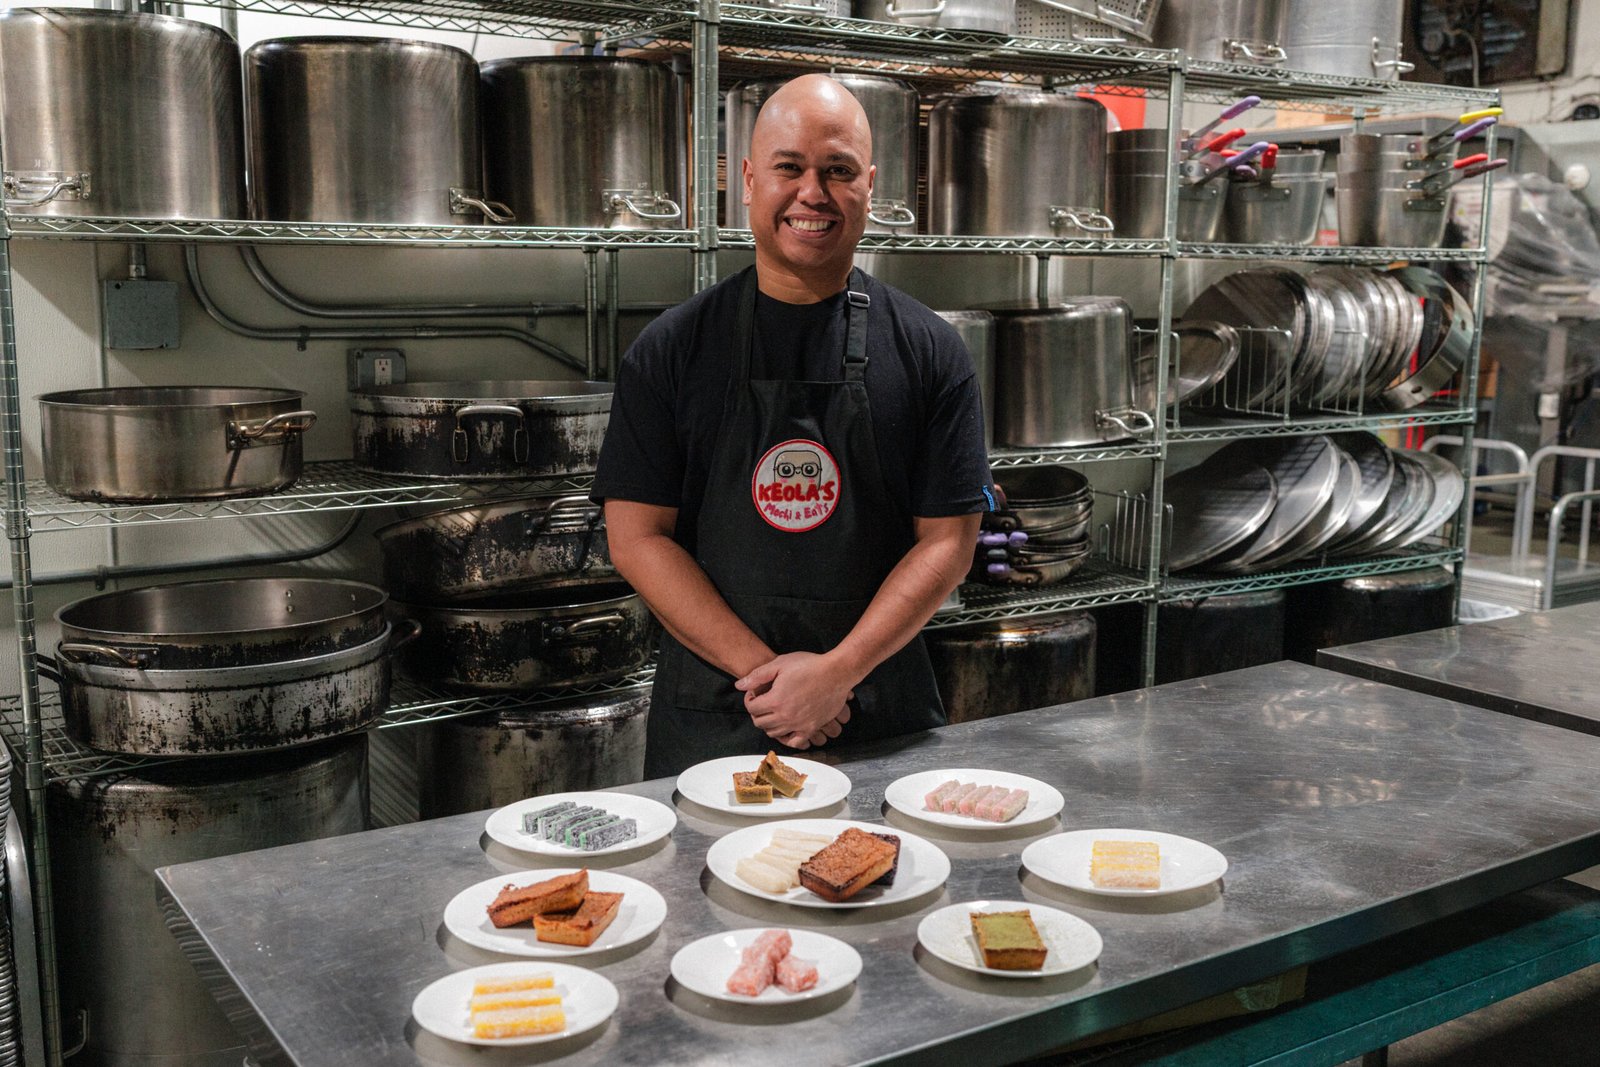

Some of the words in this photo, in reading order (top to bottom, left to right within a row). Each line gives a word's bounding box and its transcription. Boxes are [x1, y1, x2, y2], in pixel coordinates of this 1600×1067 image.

[758, 480, 835, 502] KEOLA'S
[764, 502, 792, 521] Mochi
[795, 511, 802, 520] &
